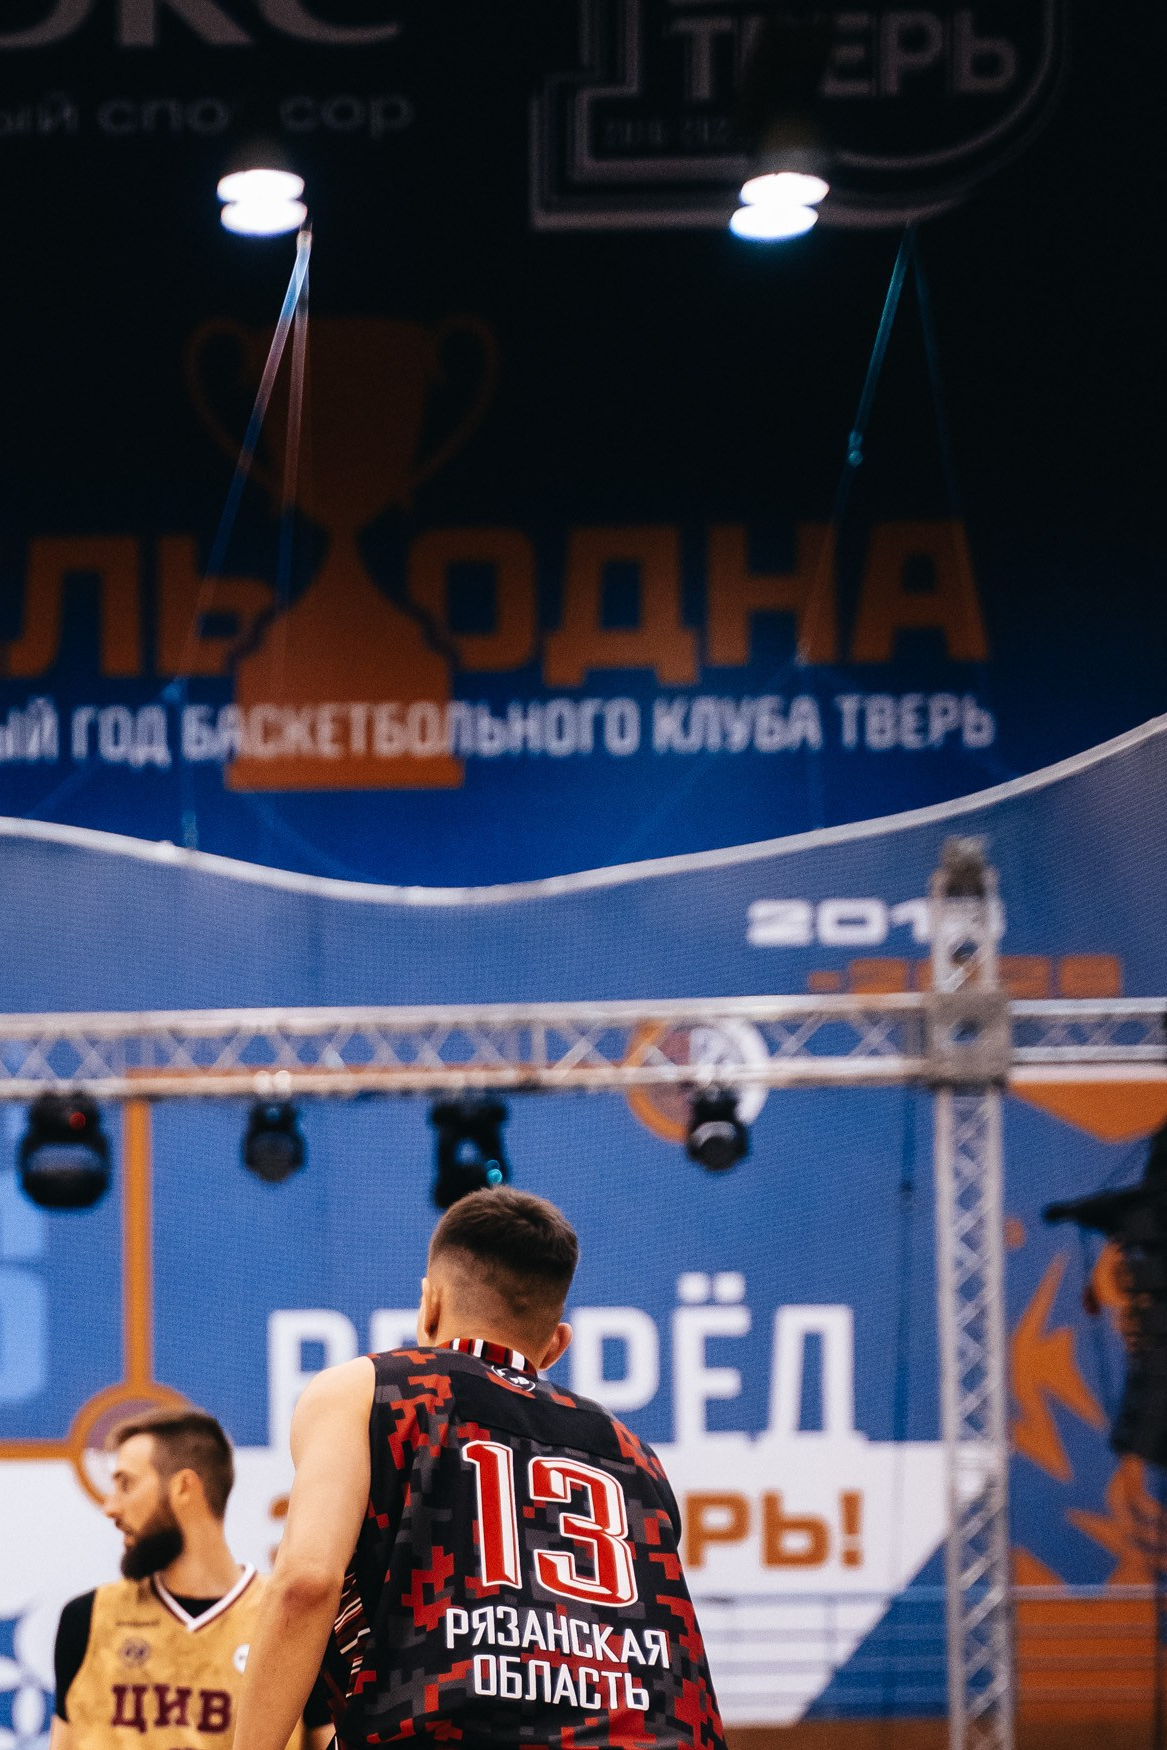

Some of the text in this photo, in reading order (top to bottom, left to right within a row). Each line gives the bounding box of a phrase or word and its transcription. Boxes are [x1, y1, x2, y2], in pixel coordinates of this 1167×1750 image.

[668, 10, 1019, 101] ТЕРЬ
[97, 90, 415, 138] спосор
[408, 522, 990, 688] ОДНА
[73, 704, 173, 767] ГОД
[181, 698, 640, 762] БАСКЕТБОЛЬНОГО
[652, 694, 822, 756] КЛУБА
[836, 692, 995, 751] ТВЕРЬ
[746, 898, 1006, 947] 201
[462, 1439, 639, 1607] 13
[445, 1606, 670, 1669] РЯЗАНСКАЯ
[473, 1655, 650, 1711] ОБЛАСТЬ
